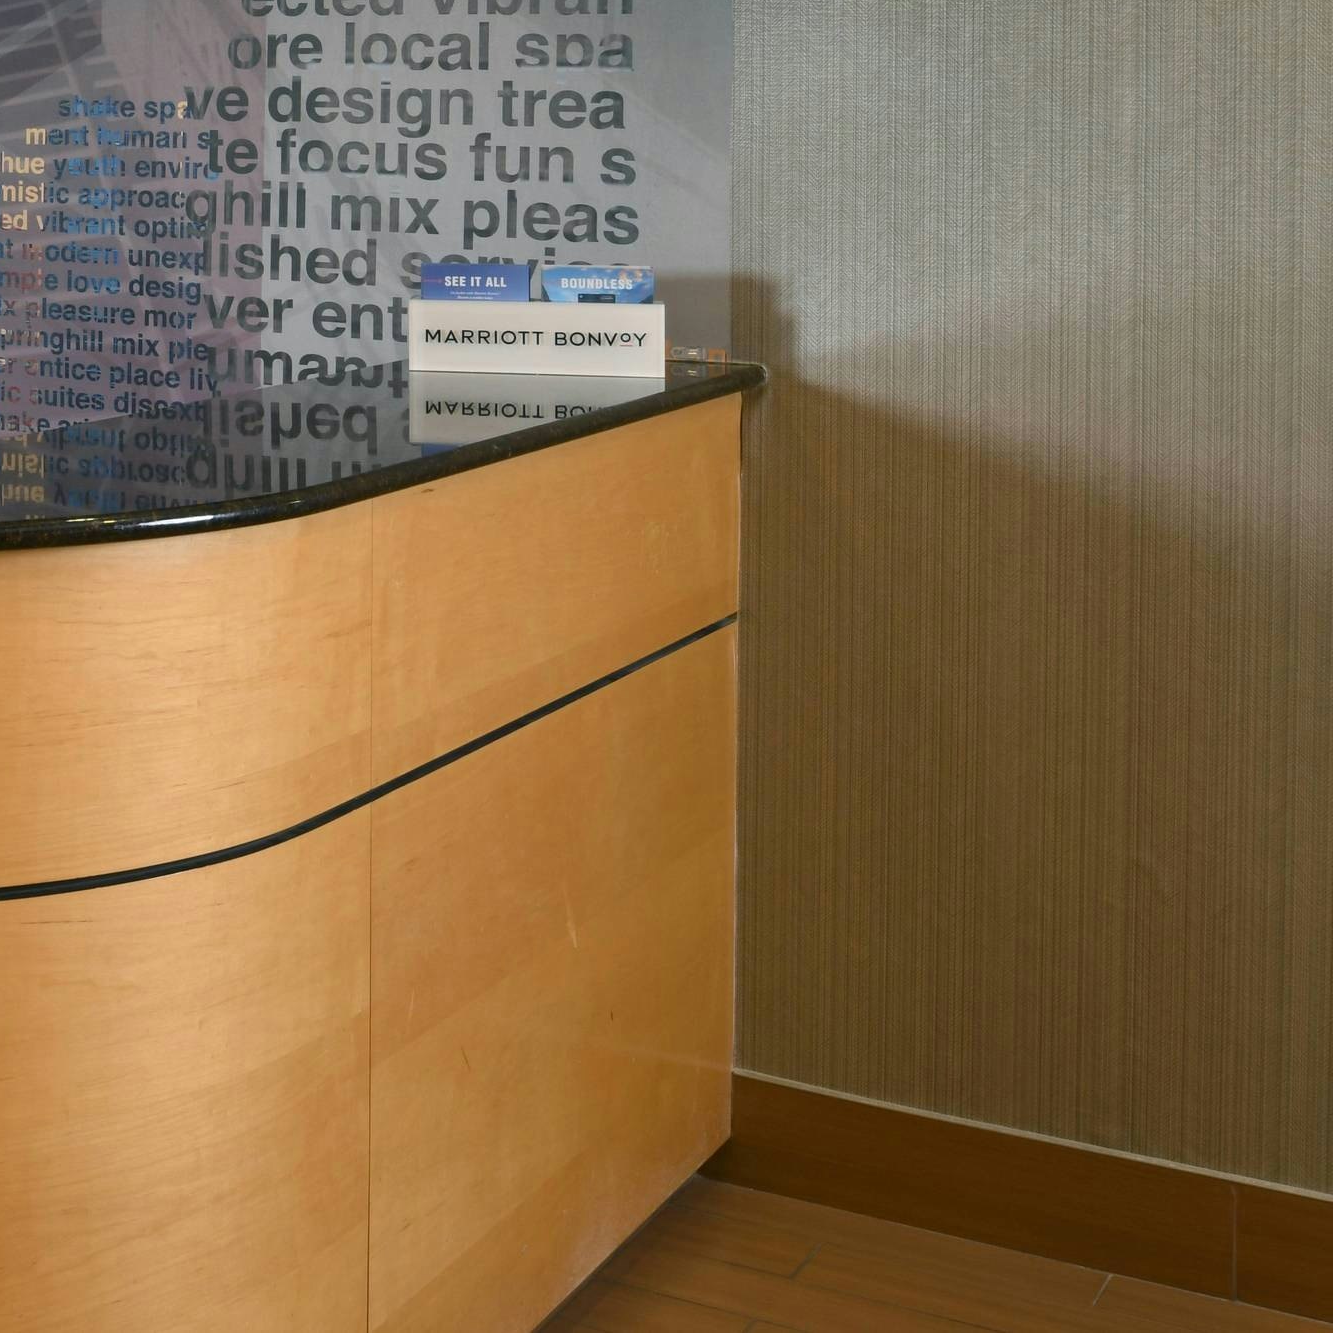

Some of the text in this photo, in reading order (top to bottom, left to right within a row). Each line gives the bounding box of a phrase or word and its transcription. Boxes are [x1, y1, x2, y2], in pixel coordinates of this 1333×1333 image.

[228, 30, 323, 70] ore
[345, 21, 490, 71] local
[59, 95, 136, 118] shake
[185, 75, 626, 138] ve design trea
[25, 125, 90, 146] ment
[97, 125, 187, 150] human
[0, 150, 45, 175] hue
[53, 154, 126, 180] youth
[207, 129, 637, 186] te focus fun s
[37, 211, 125, 236] vibrant
[185, 180, 640, 250] ghill mix pleas
[203, 231, 377, 287] lished
[67, 270, 121, 295] love
[128, 274, 201, 305] desig
[444, 276, 507, 288] SEE IT ALL
[560, 277, 635, 290] BOUNDLESS
[25, 298, 135, 326] pleasure
[144, 308, 197, 330] mor
[203, 294, 408, 343] ver ent
[112, 333, 160, 357] mix
[425, 329, 647, 347] MARRIOTT BONVOY
[25, 357, 102, 382] entice
[110, 362, 181, 388] place
[30, 386, 106, 411] suites
